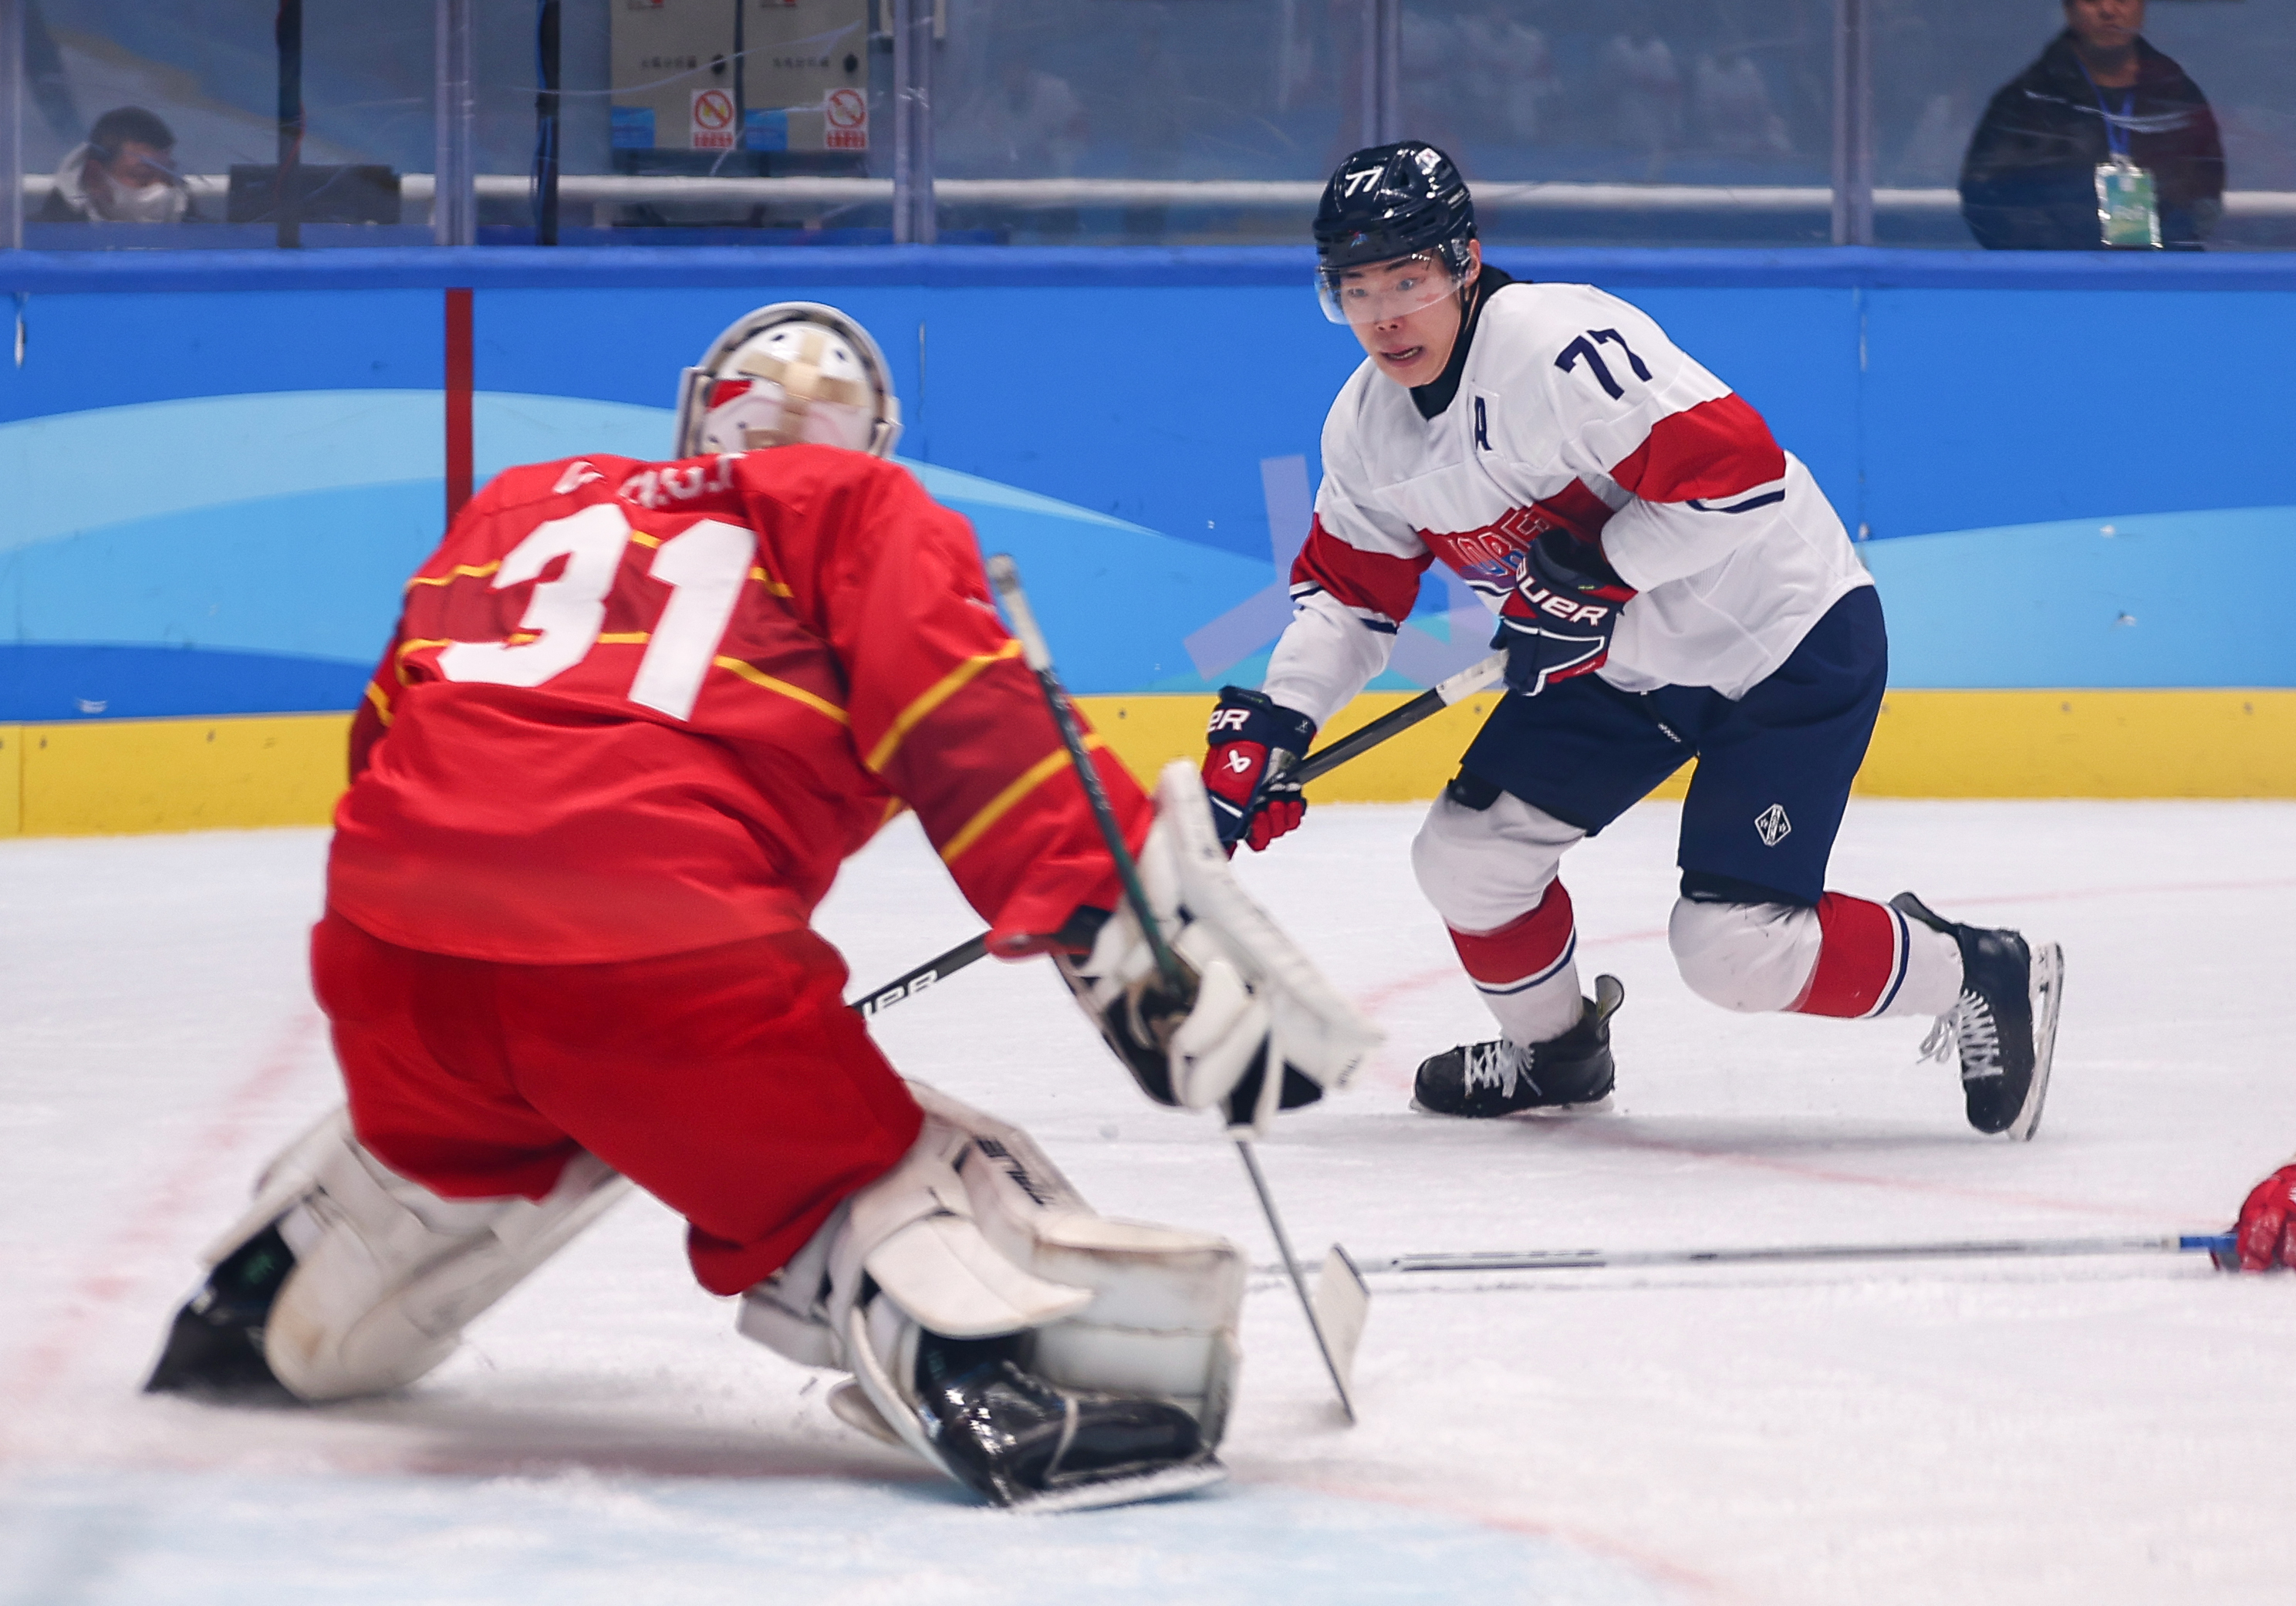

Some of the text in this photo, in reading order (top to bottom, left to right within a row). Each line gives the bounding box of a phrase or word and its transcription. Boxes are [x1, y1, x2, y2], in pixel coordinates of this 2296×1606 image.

[1345, 165, 1385, 198] 77
[1553, 328, 1653, 400] 77
[1474, 395, 1492, 451] A
[436, 502, 758, 722] 31
